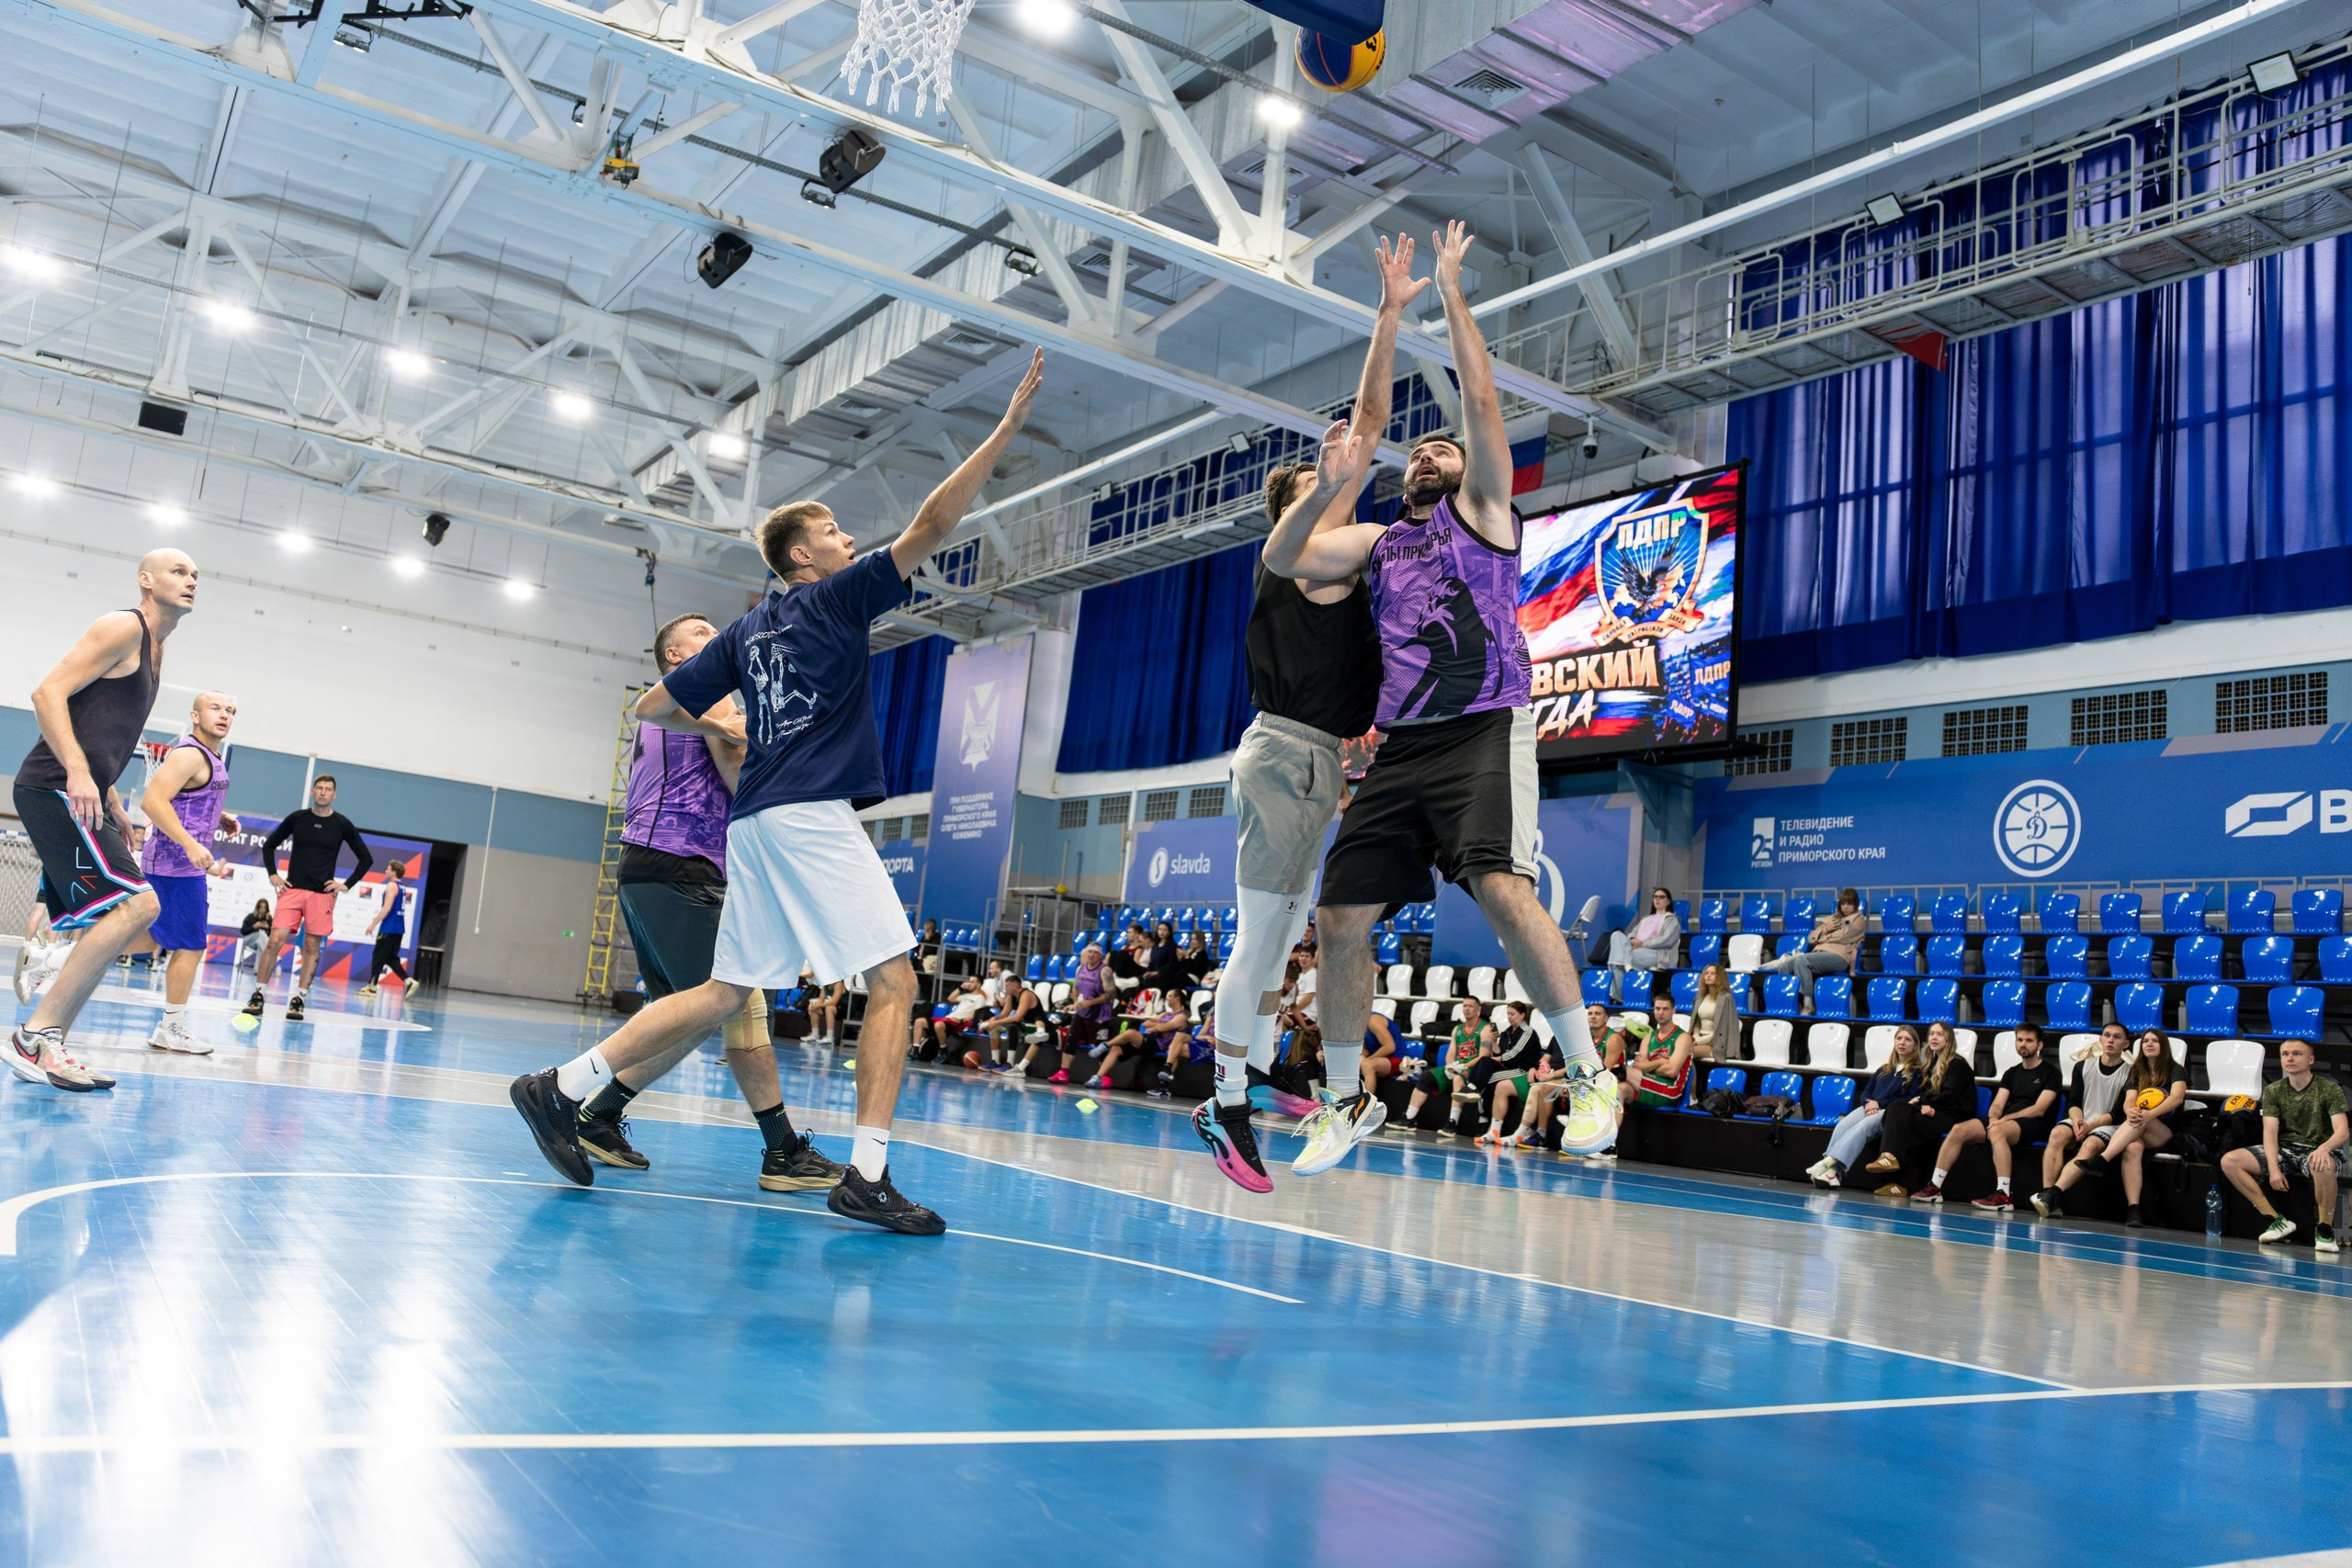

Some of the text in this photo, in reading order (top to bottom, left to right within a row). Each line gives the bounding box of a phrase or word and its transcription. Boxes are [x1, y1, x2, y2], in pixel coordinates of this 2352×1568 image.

[1616, 511, 1687, 551] ЛДПР
[1694, 660, 1731, 685] ЛДПР
[1526, 689, 1598, 739] ГДА
[1781, 816, 1854, 831] ТЕЛЕВИДЕНИЕ
[1779, 834, 1825, 848] И РАДИО
[1170, 852, 1211, 874] slavda
[1751, 860, 1773, 868] РЕГИОН
[1779, 847, 1886, 863] ПРИМОРСКОГО КРАЯ
